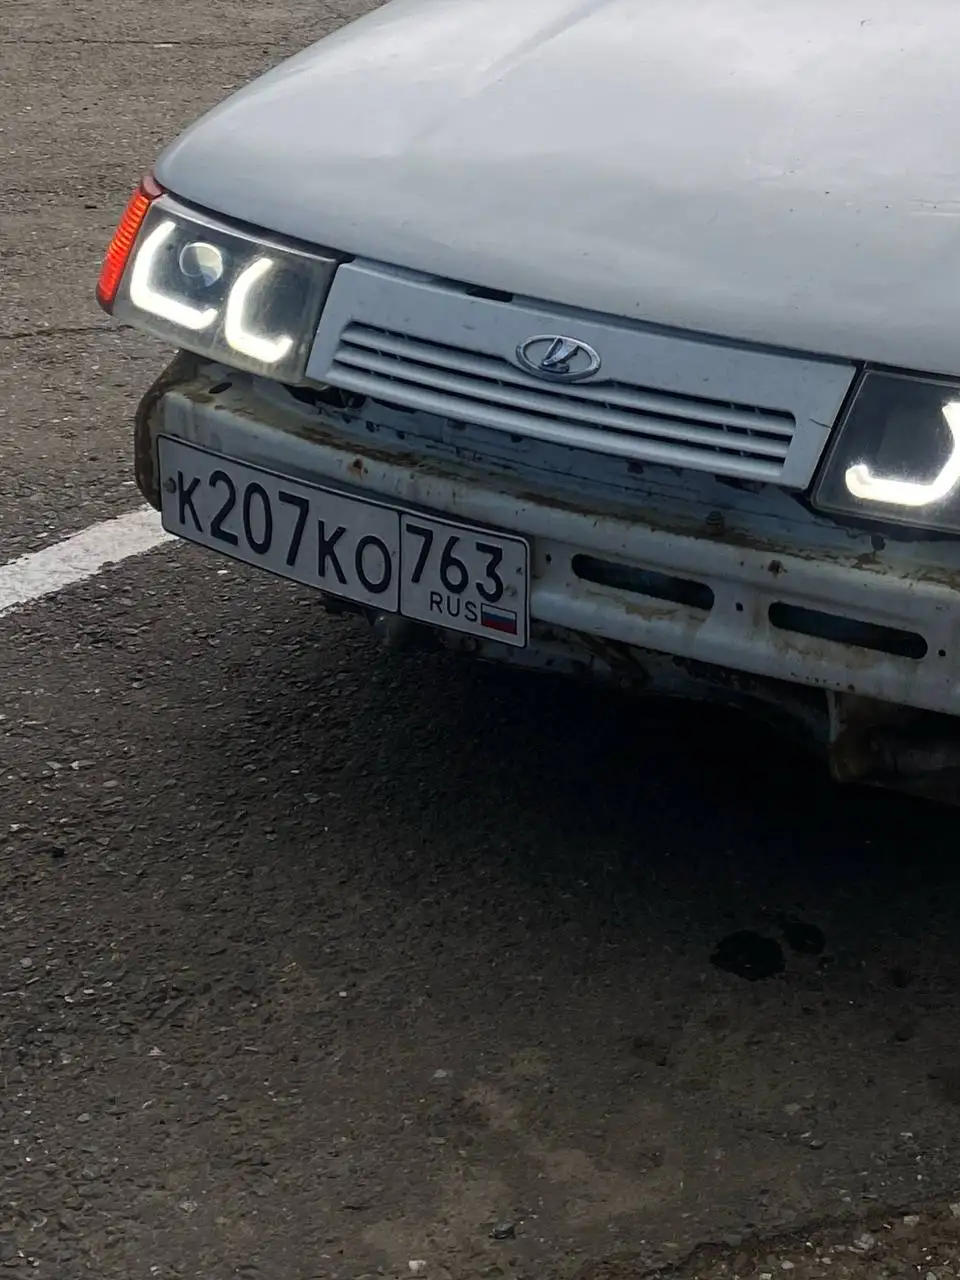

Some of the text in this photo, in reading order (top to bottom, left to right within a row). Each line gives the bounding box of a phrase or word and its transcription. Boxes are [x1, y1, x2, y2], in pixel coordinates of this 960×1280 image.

[177, 470, 504, 604] К207КО 763
[429, 591, 478, 622] RUS
